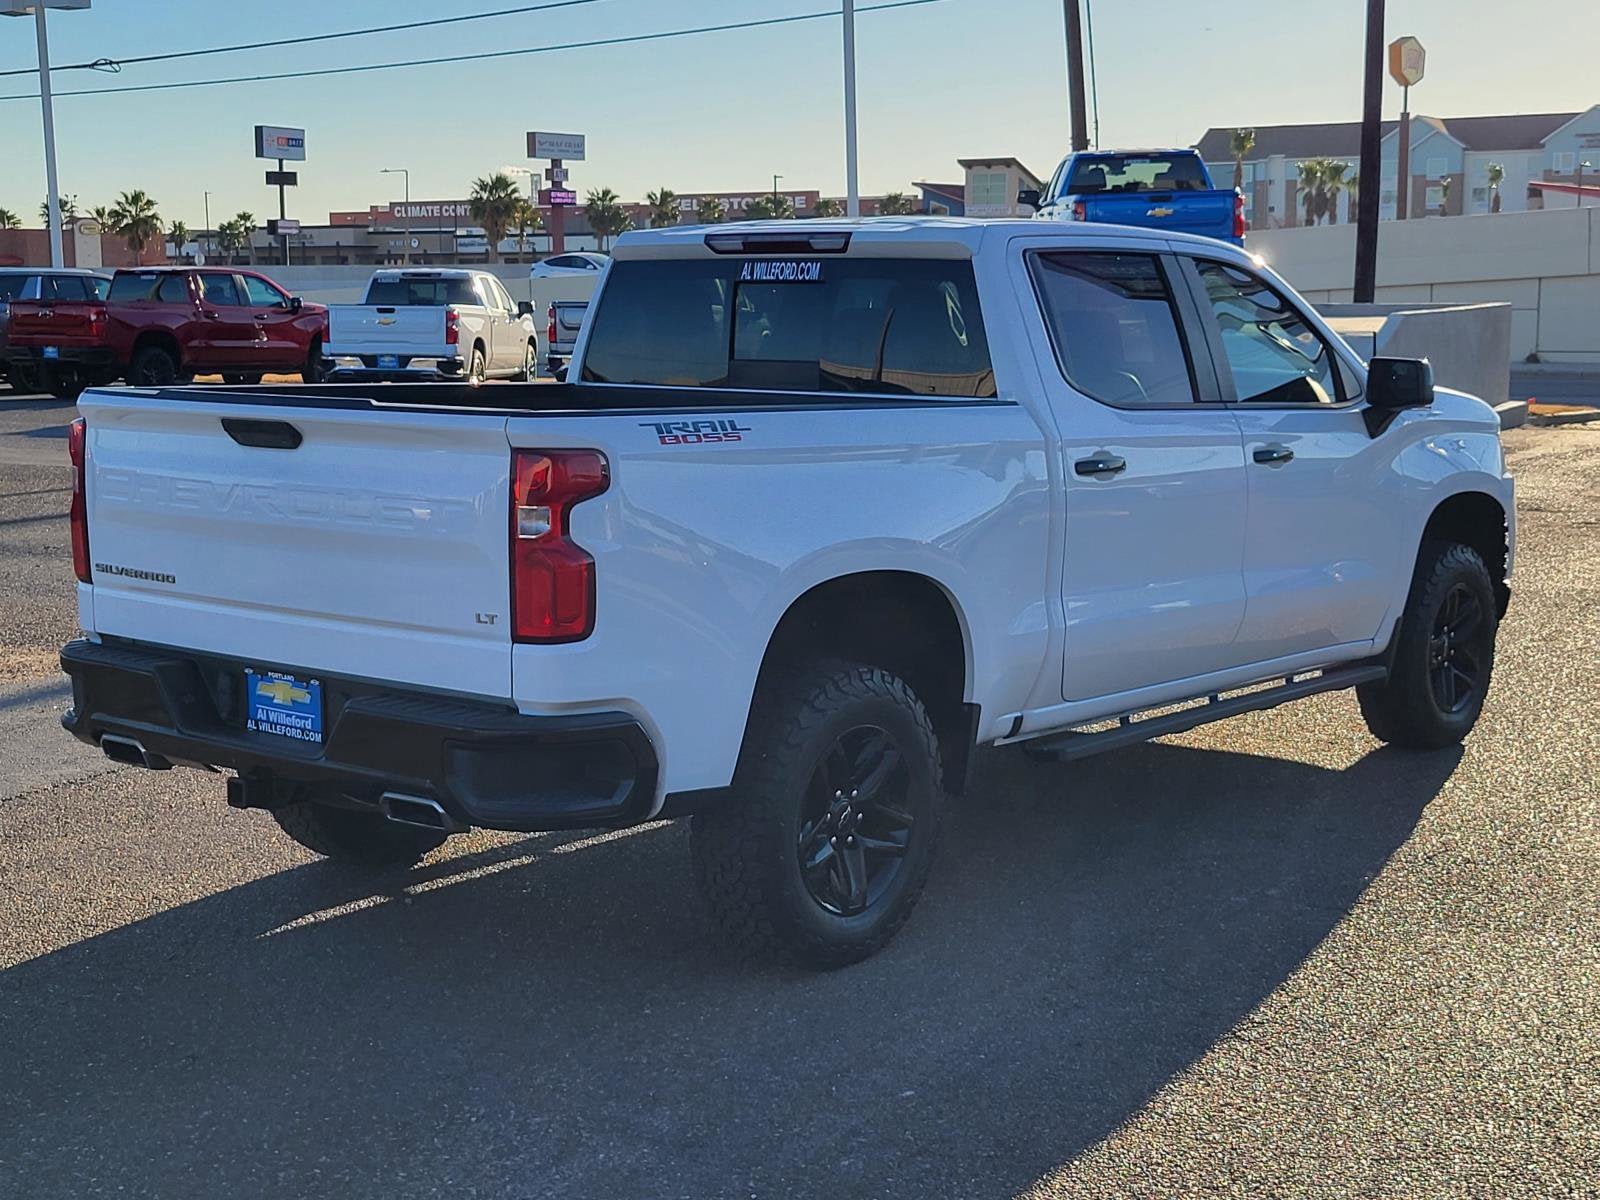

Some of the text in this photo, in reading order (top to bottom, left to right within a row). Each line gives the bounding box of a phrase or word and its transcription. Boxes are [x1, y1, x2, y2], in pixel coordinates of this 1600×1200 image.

[394, 204, 472, 218] CLIMATE CONT
[719, 196, 806, 210] STOGE
[741, 262, 821, 280] AL WILLEFORD.COM
[638, 419, 752, 435] TRAIL
[658, 431, 742, 445] BOSS
[97, 470, 468, 534] CHEVROLET
[95, 562, 176, 585] SILVERADO
[475, 612, 498, 626] LT
[267, 671, 295, 682] PORTLAND
[257, 708, 312, 730] Al Willeford
[247, 719, 322, 743] AL WILLEFORD.COM
